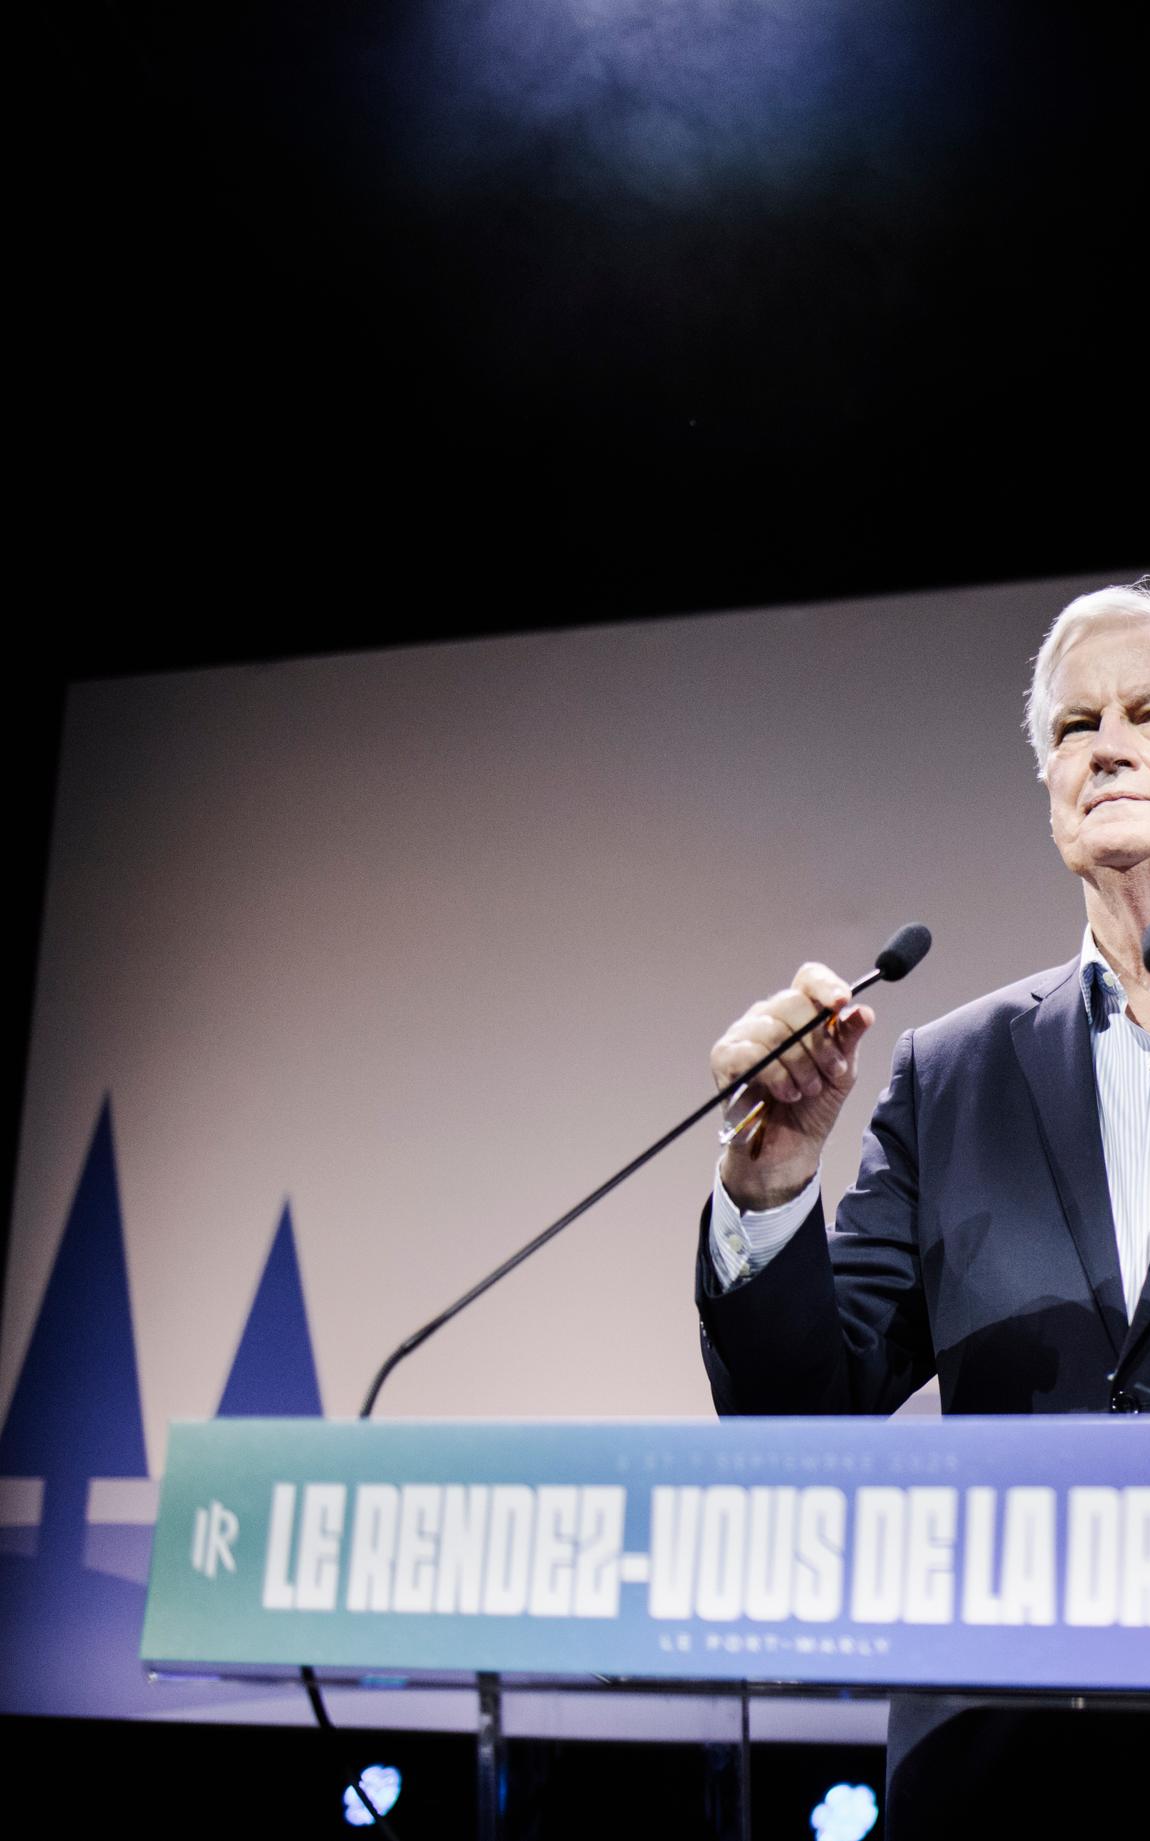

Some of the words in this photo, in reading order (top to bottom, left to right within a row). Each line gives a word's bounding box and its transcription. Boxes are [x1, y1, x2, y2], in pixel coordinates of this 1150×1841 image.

[262, 1482, 347, 1611] LE
[345, 1482, 847, 1622] RENDEZ-VOUS
[850, 1485, 958, 1626] DE
[961, 1485, 1057, 1627] LA
